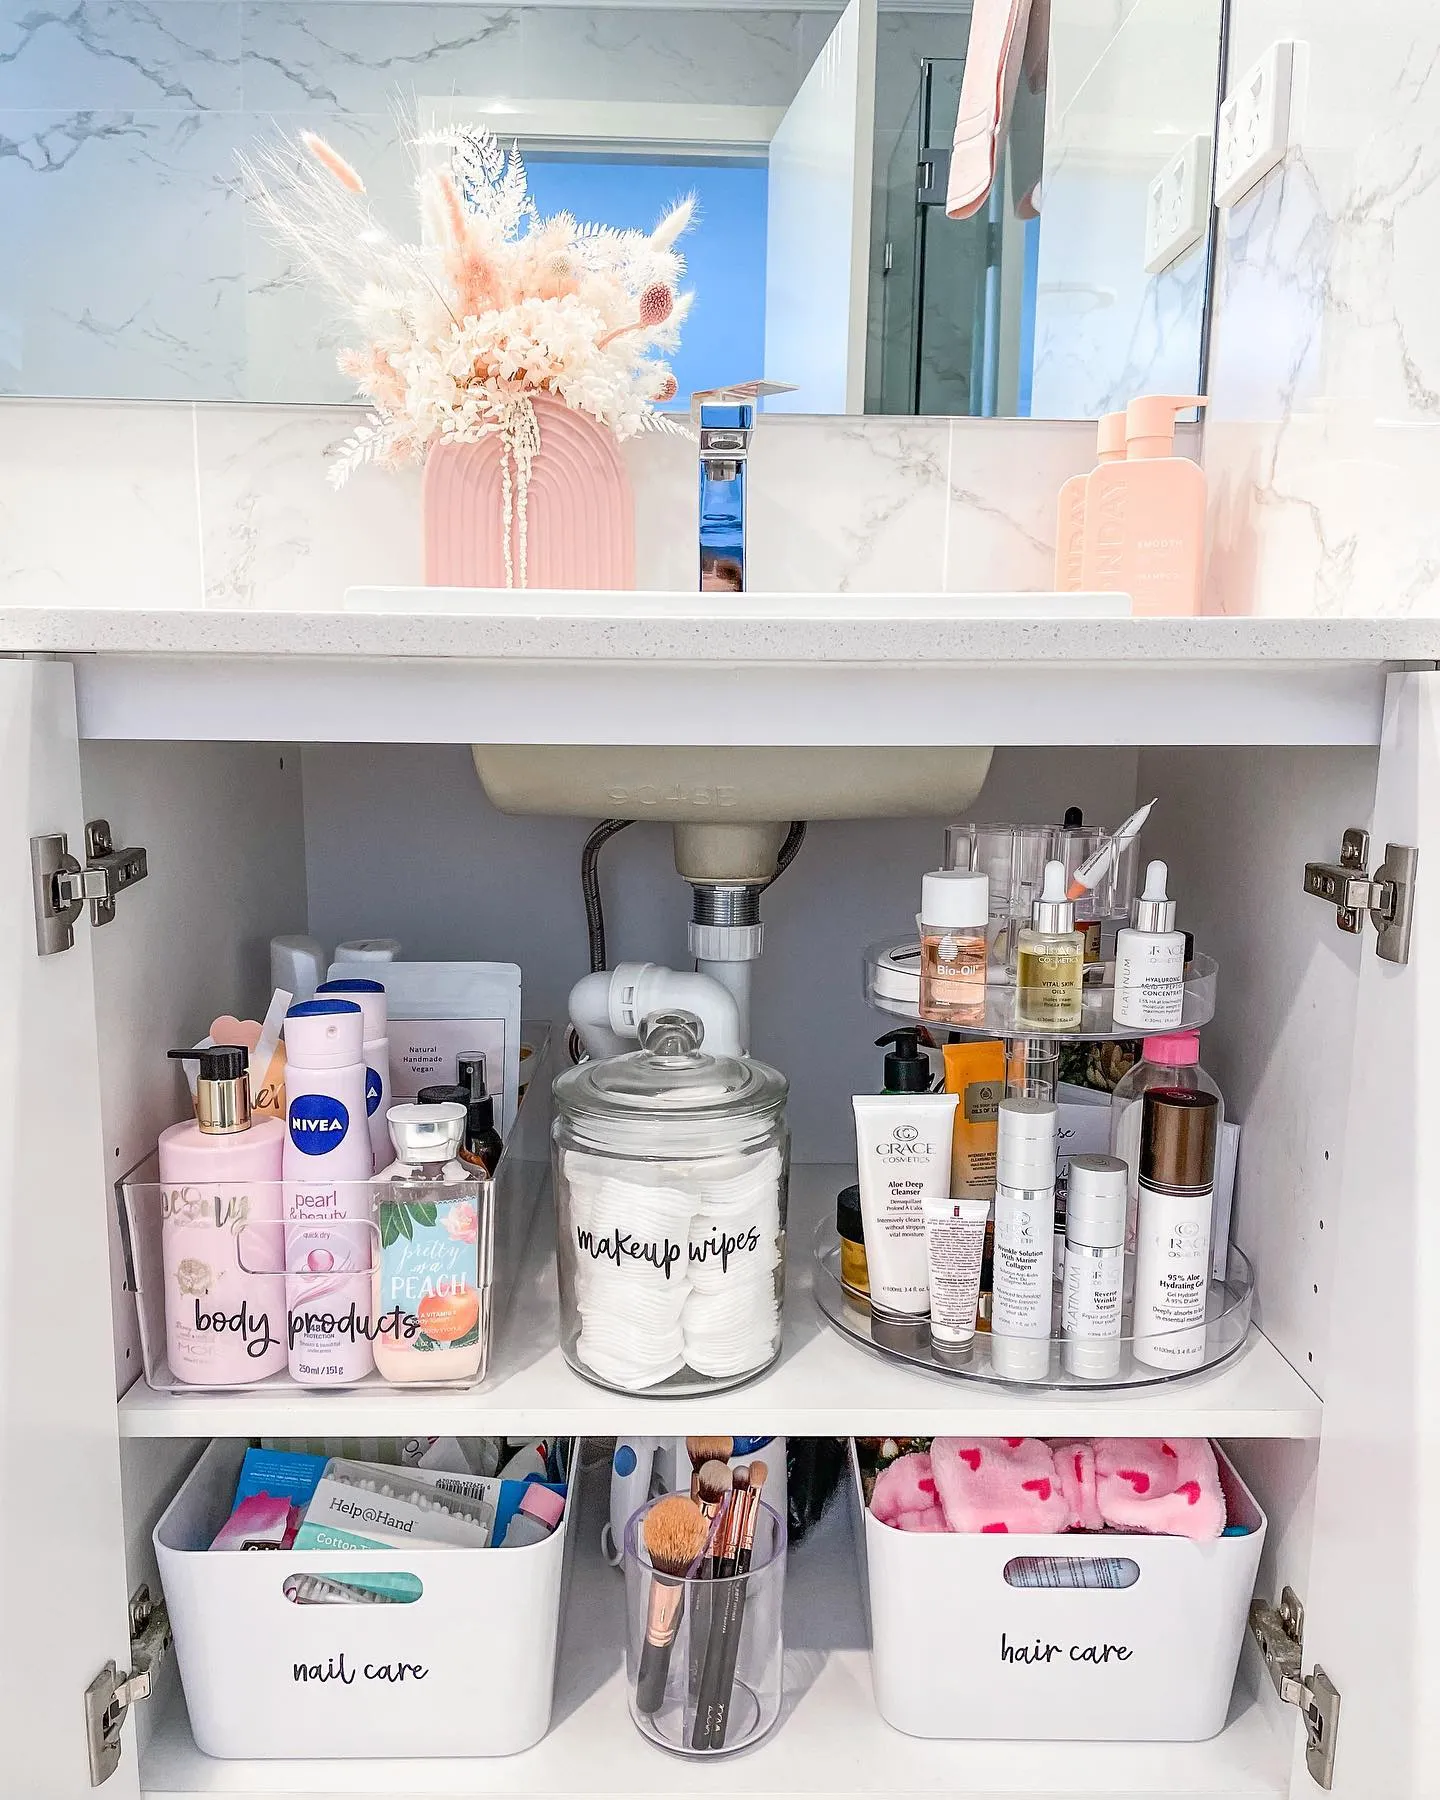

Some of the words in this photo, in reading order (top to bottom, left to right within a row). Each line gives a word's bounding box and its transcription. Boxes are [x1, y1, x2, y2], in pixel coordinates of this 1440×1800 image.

[938, 964, 976, 976] Bio-Oil
[292, 1116, 343, 1132] NIVEA
[876, 1143, 937, 1156] GRACE
[905, 1180, 924, 1189] Deep
[295, 1190, 337, 1209] pearl
[577, 1225, 681, 1280] makeup
[688, 1226, 761, 1273] wipes
[998, 1244, 1018, 1256] Wrinkle
[1001, 1252, 1014, 1261] With
[1005, 1260, 1032, 1270] Collagen
[391, 1271, 468, 1300] PEACH
[1160, 1280, 1194, 1290] Hydrating
[1066, 1266, 1080, 1333] PLATINUM
[1152, 1306, 1172, 1315] Deeply
[195, 1298, 281, 1358] body
[288, 1302, 421, 1351] products
[329, 1497, 414, 1532] Help@Hand
[1001, 1632, 1062, 1664] hair
[1069, 1644, 1134, 1664] care
[293, 1652, 356, 1684] nail
[364, 1662, 430, 1682] care
